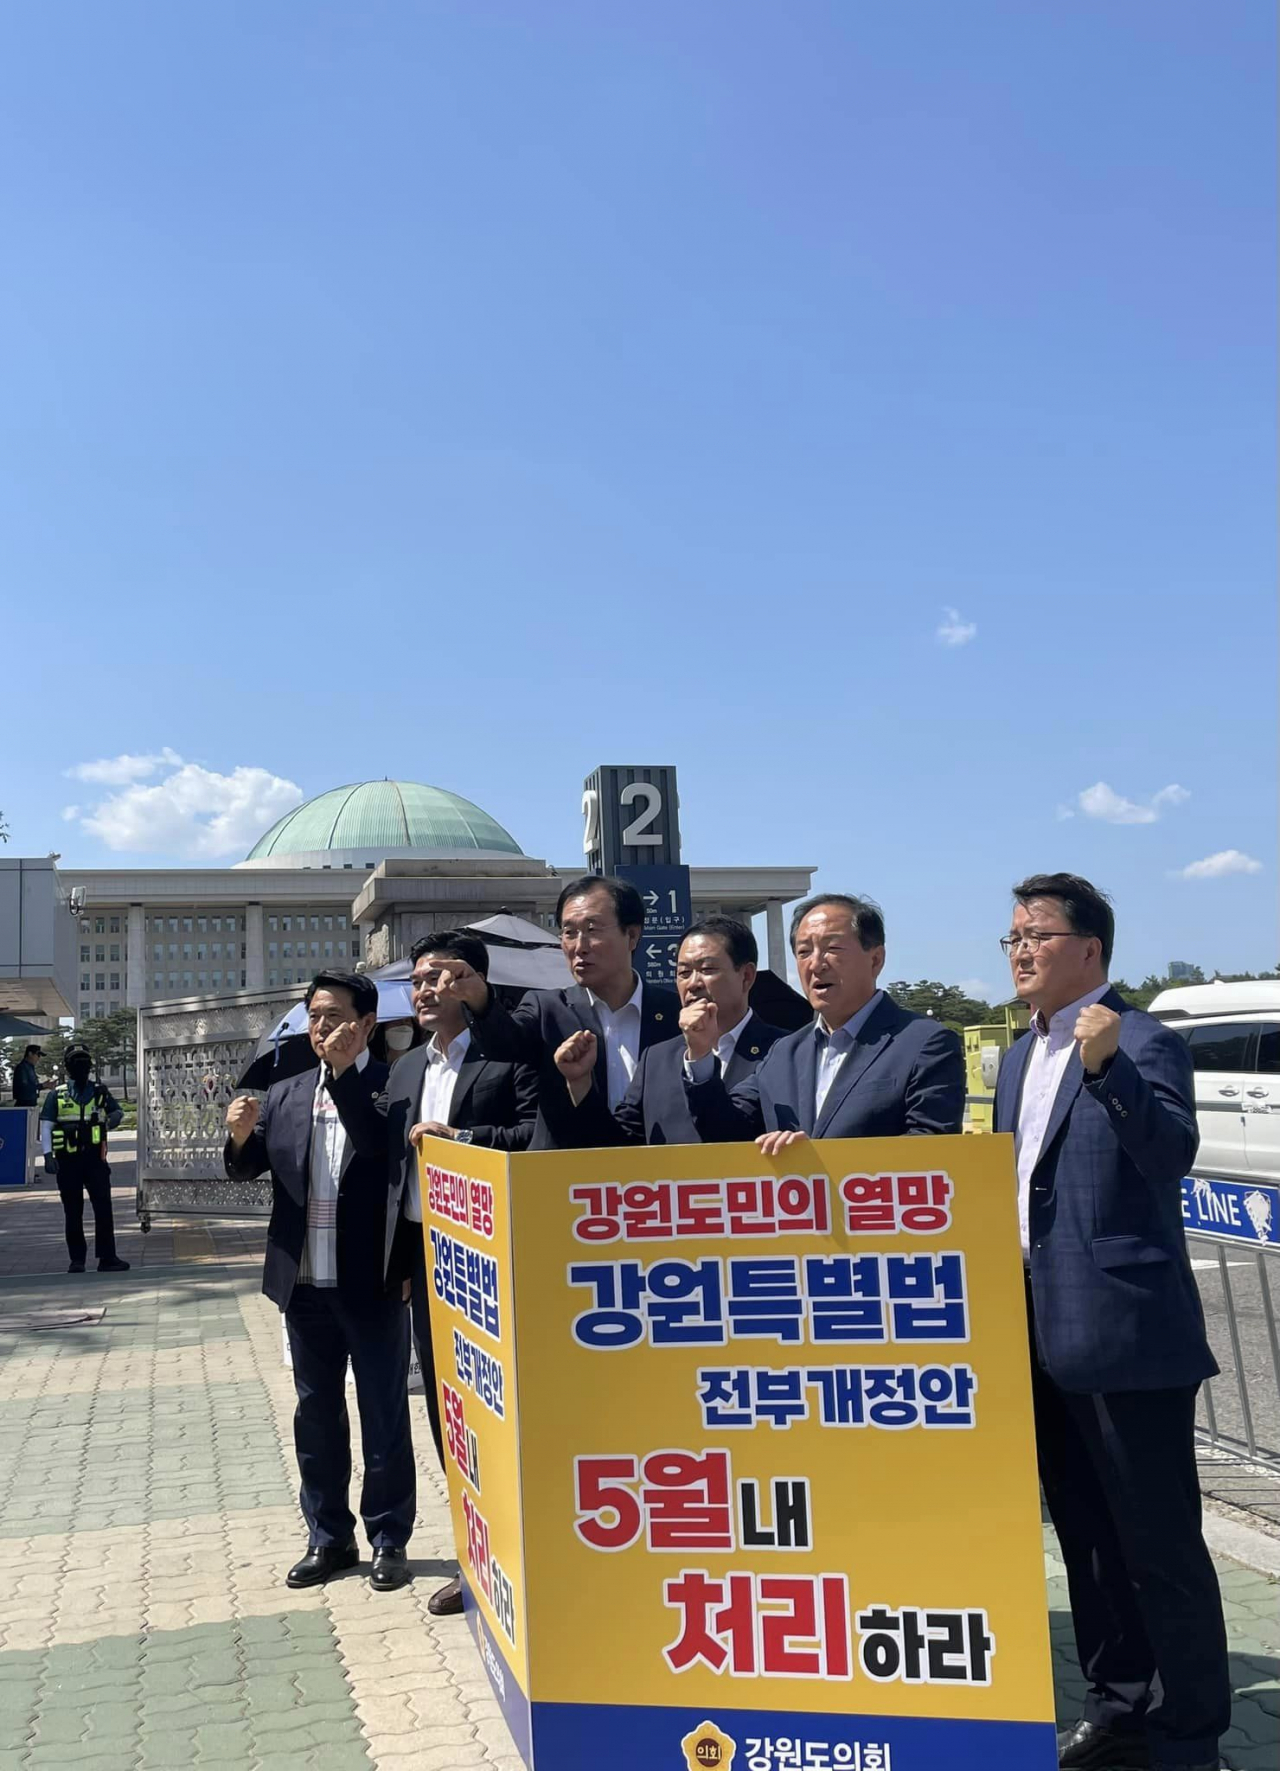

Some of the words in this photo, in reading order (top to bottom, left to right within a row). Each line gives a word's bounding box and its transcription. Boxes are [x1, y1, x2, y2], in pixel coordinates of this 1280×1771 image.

[581, 789, 600, 854] 2
[620, 782, 663, 845] 2
[668, 889, 677, 913] 1
[425, 1165, 469, 1226] 강원도민의
[470, 1181, 494, 1237] 열망
[573, 1177, 828, 1240] 강원도민의
[843, 1174, 951, 1232] 열망
[1196, 1187, 1242, 1226] LINE
[430, 1228, 500, 1340] 강원특별법
[570, 1254, 967, 1346] 강원특별법
[454, 1330, 503, 1418] 전부개정안
[700, 1368, 974, 1426] 전부개정안
[697, 1744, 722, 1761] 의회
[744, 1737, 891, 1771] 강원도의회
